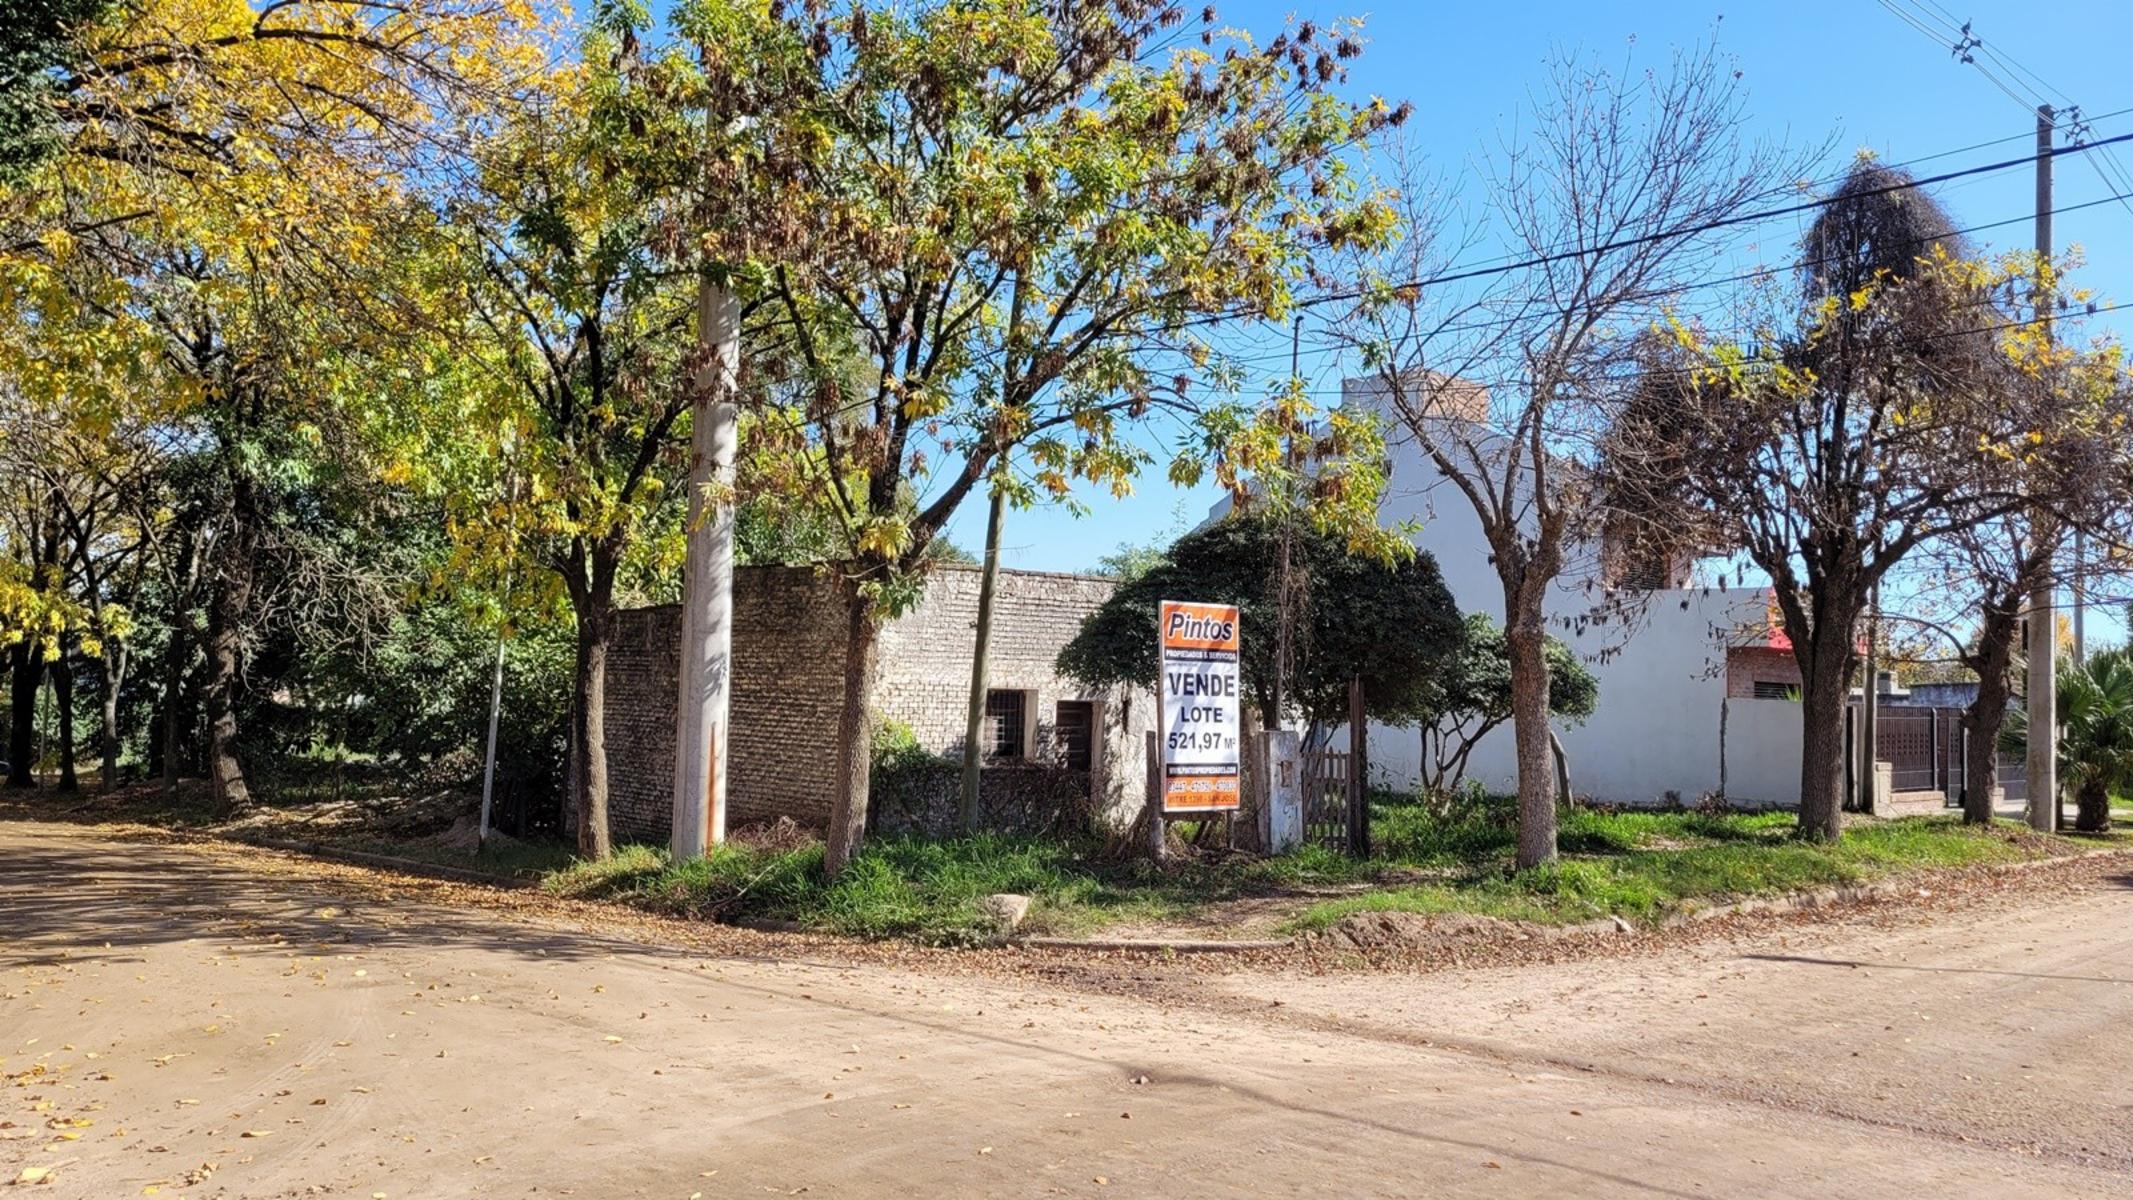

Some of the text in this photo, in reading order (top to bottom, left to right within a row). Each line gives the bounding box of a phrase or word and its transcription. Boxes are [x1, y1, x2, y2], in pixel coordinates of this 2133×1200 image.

[1168, 612, 1233, 640] Pintos
[1168, 672, 1235, 697] VENDE
[1181, 706, 1223, 723] LOTE
[1168, 732, 1222, 753] 521,97
